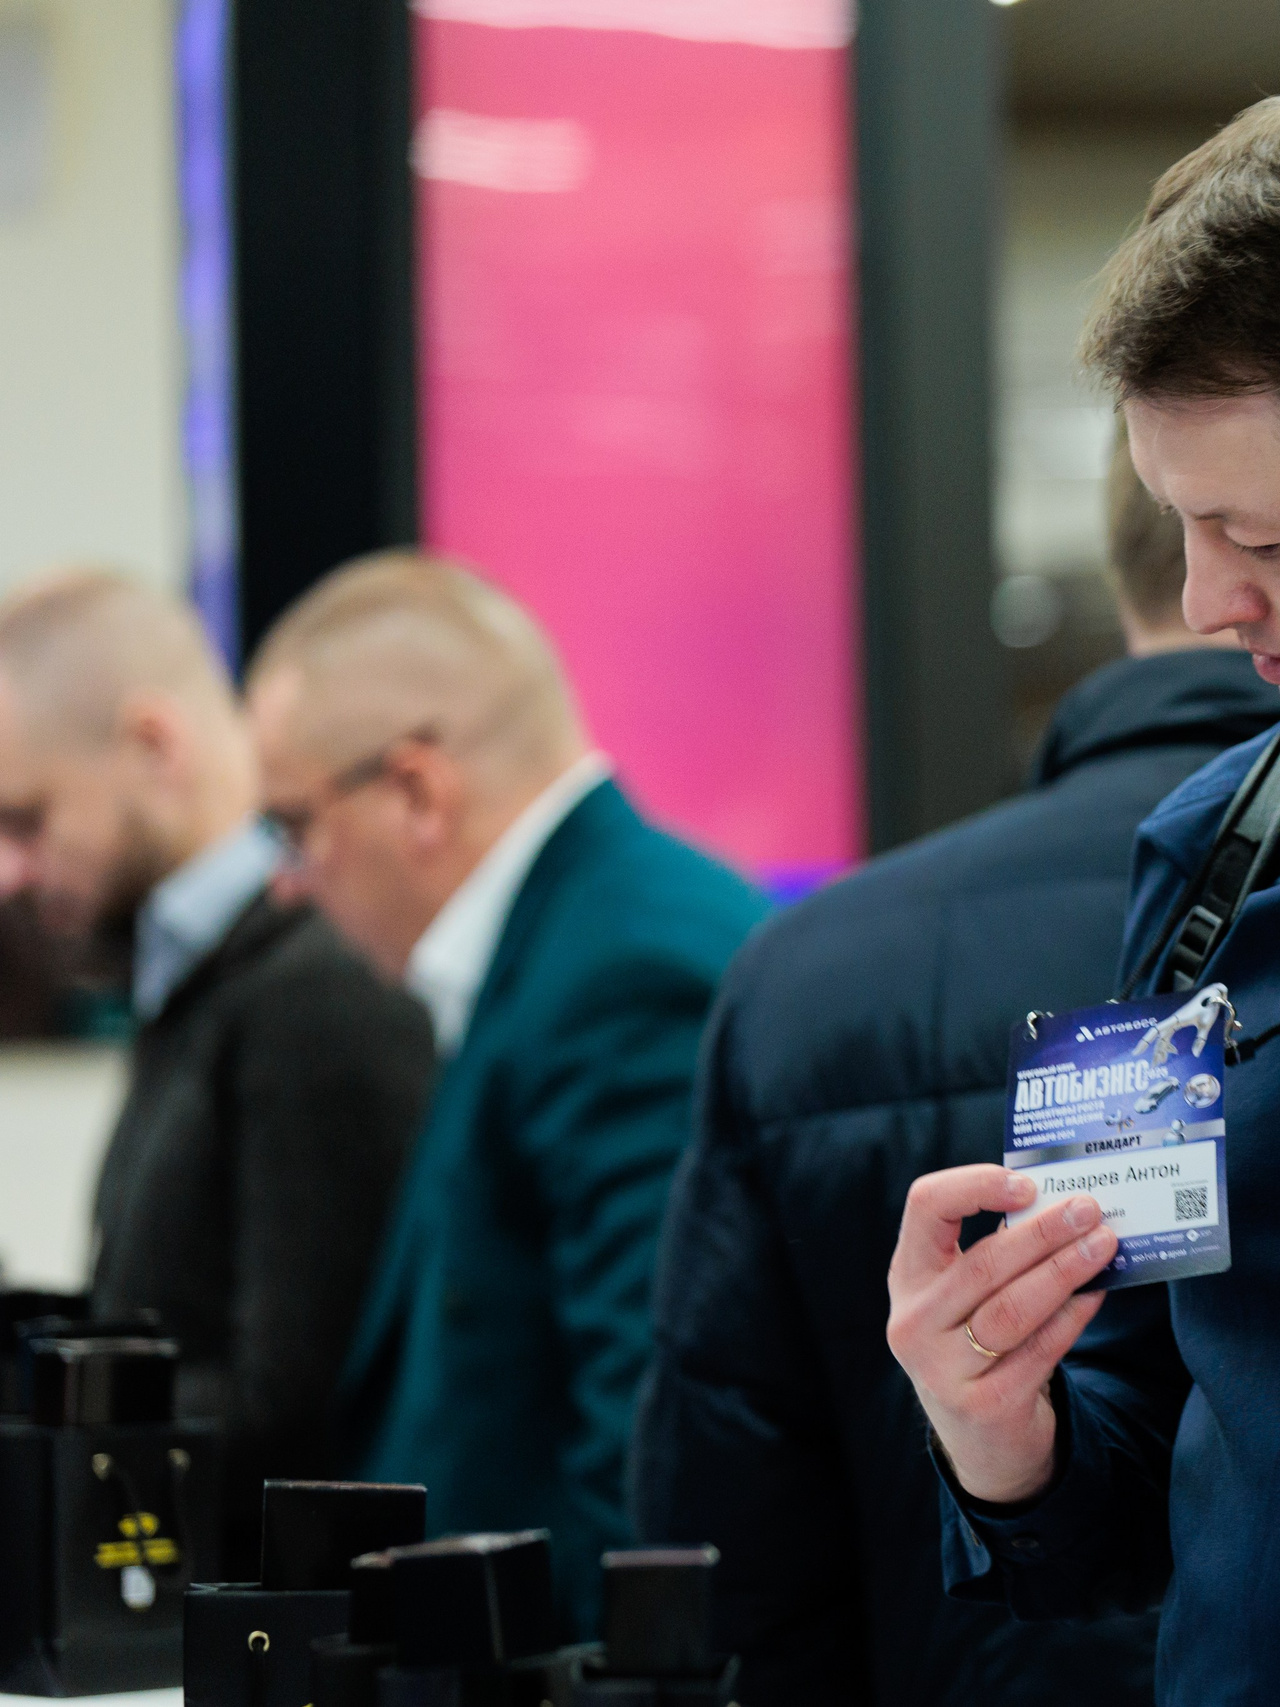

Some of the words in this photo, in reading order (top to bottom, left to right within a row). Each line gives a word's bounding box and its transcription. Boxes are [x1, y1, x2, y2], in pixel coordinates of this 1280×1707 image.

[1014, 1059, 1150, 1112] АВТОБИЗНЕС
[1085, 1135, 1142, 1154] СТАНДАРТ
[1042, 1171, 1120, 1195] Лазарев
[1125, 1162, 1181, 1183] Антон
